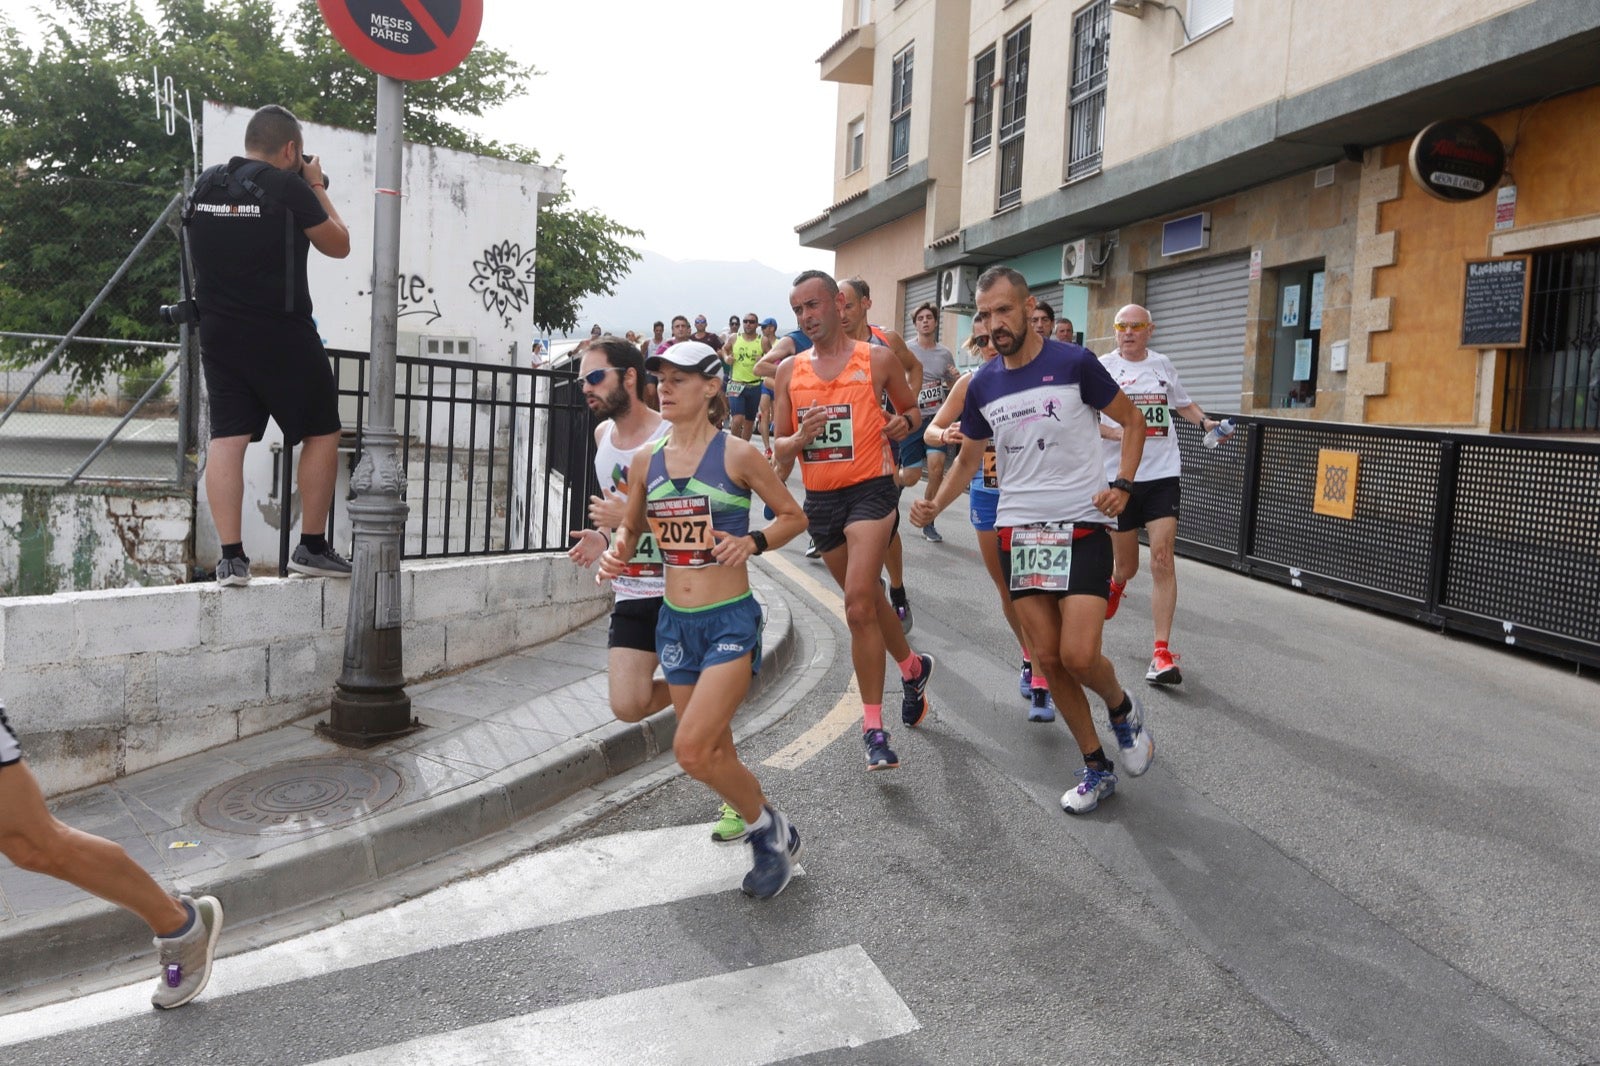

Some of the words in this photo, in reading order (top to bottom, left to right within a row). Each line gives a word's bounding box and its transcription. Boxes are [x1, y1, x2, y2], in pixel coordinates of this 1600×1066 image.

[370, 13, 413, 32] MESES
[370, 26, 409, 44] PARES
[920, 387, 941, 400] 3025
[1144, 407, 1164, 423] 48
[812, 423, 843, 444] 45
[659, 521, 707, 543] 2027
[635, 536, 654, 558] 4
[1017, 548, 1069, 570] 1034
